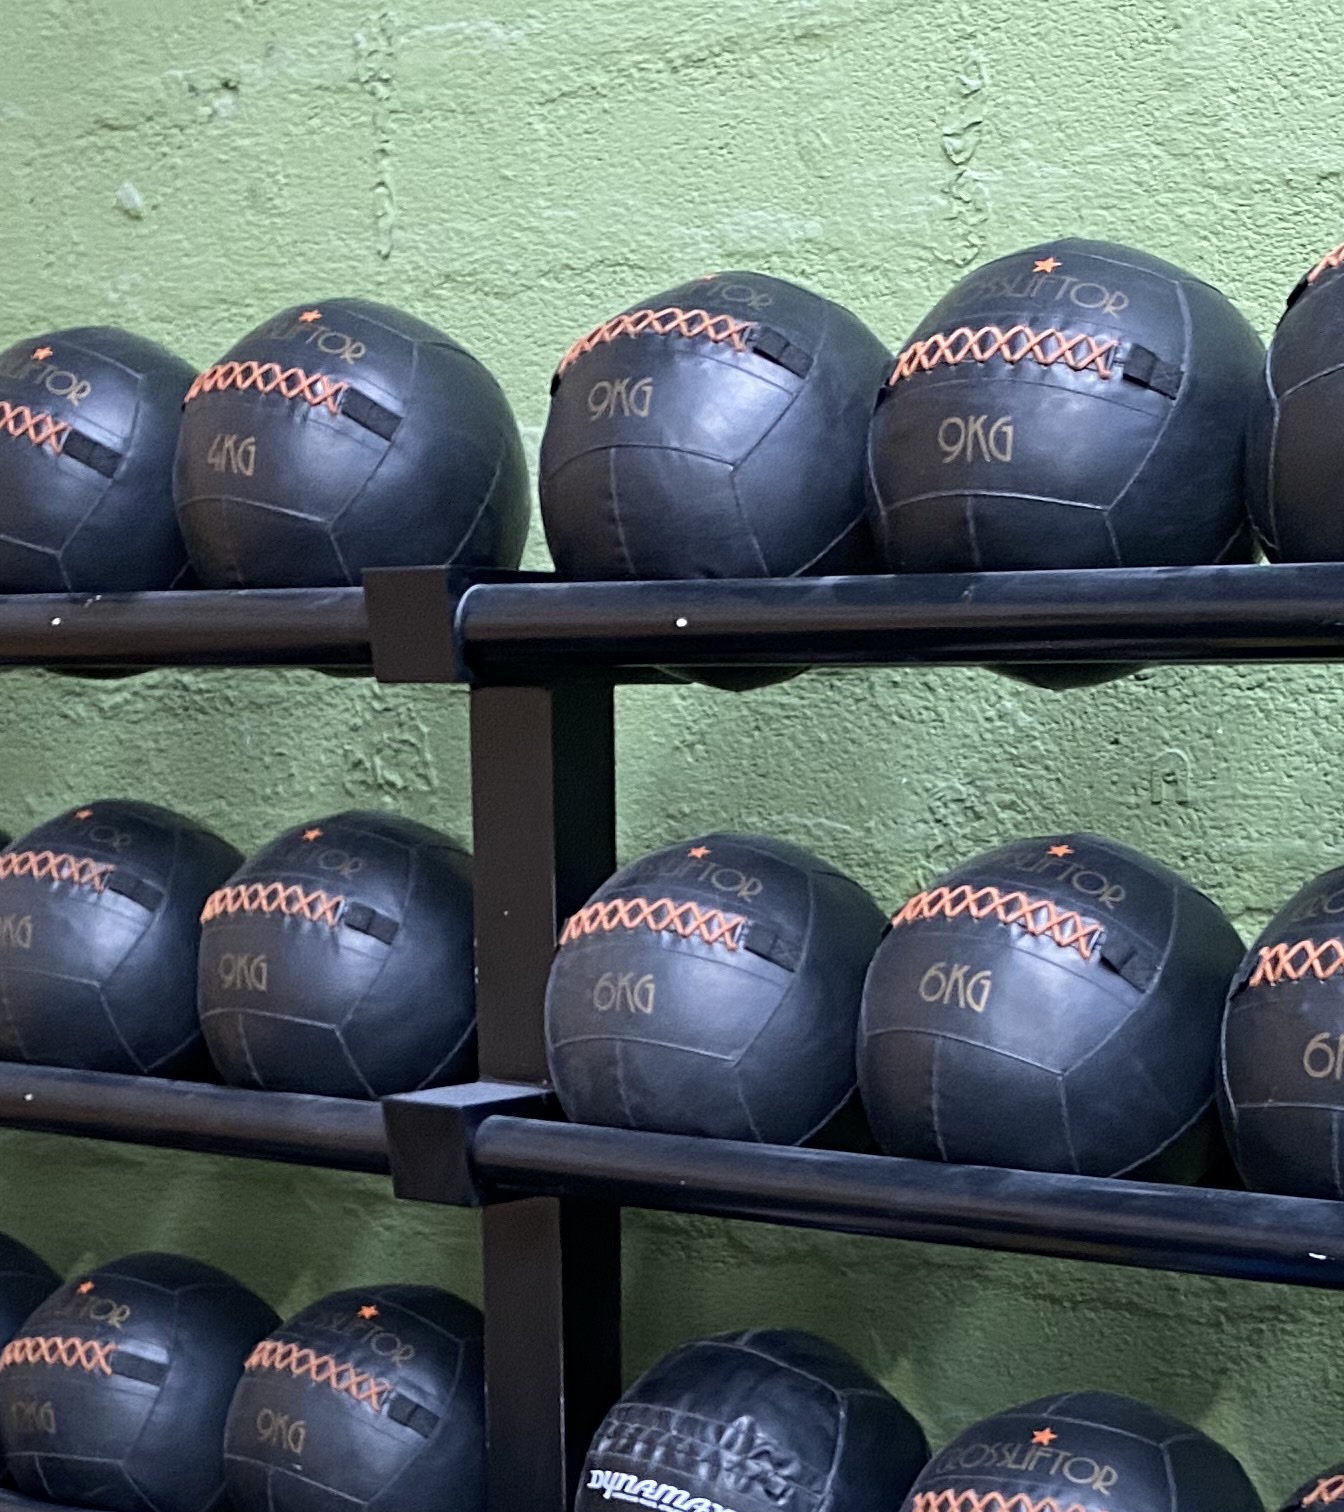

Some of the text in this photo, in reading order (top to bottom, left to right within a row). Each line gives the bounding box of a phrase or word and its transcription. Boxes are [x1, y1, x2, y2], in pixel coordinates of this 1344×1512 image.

[587, 376, 653, 421] 9KG
[207, 434, 256, 477] 4KG
[938, 415, 1014, 464] 9KG
[218, 952, 268, 993] 9KG
[592, 971, 655, 1015] 6KG
[918, 961, 993, 1014] 6KG
[256, 1407, 307, 1456] 9KG
